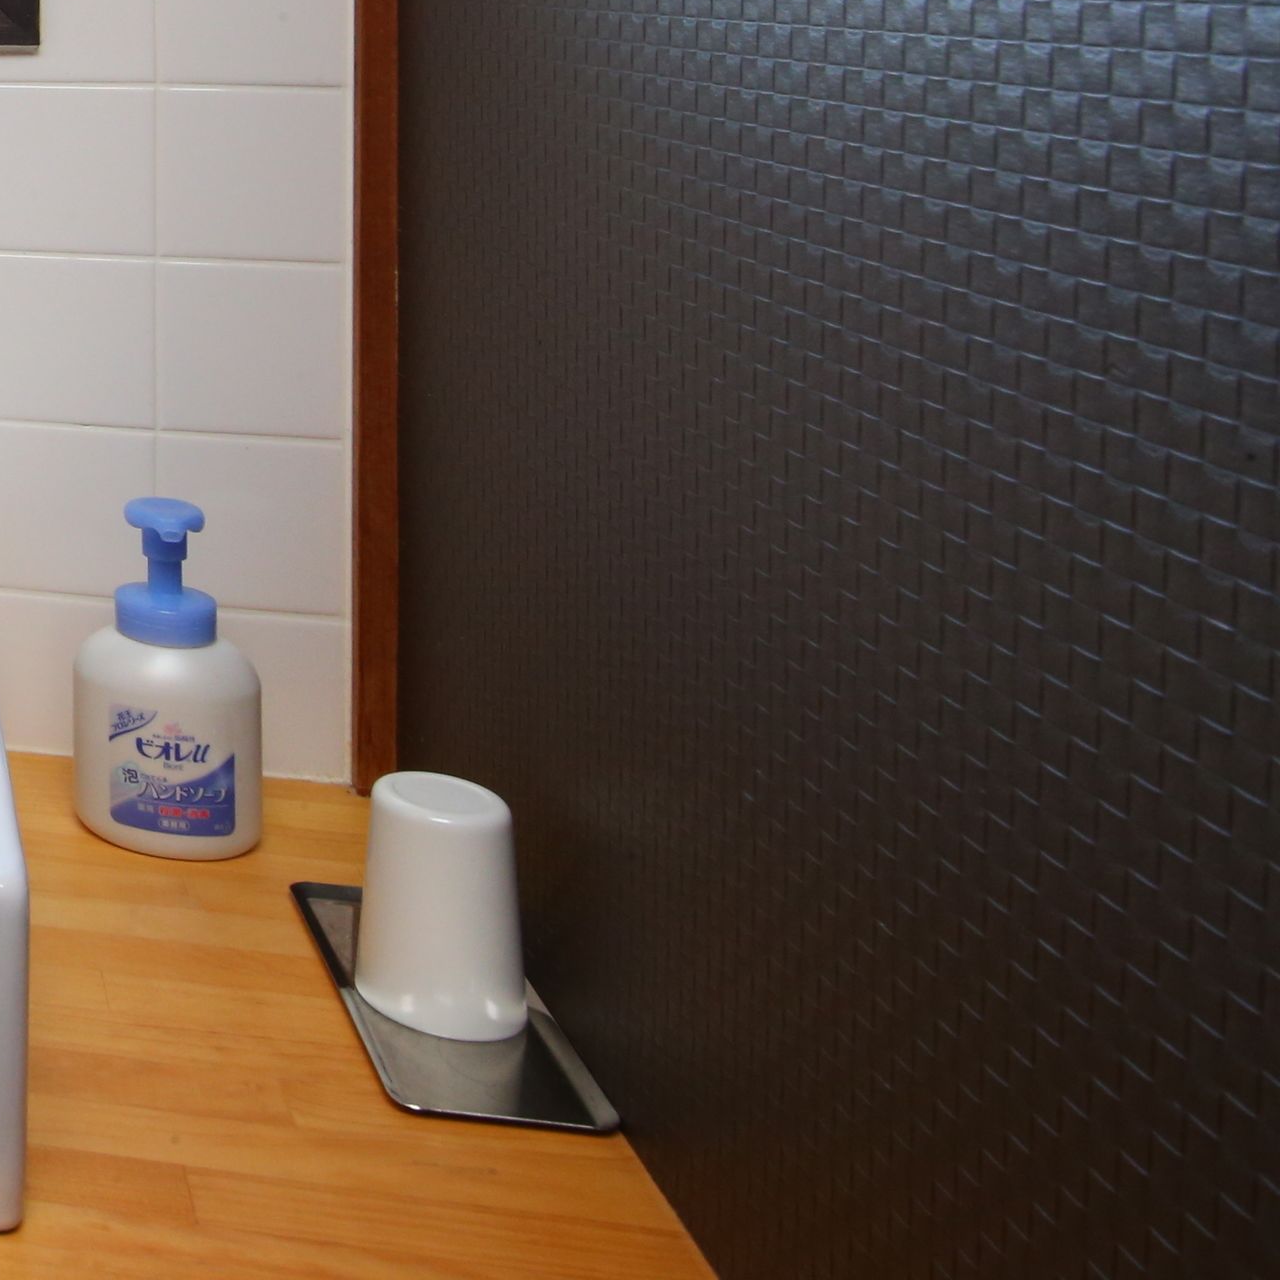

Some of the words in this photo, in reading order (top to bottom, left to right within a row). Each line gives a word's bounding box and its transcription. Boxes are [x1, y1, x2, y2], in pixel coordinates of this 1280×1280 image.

[137, 781, 228, 803] ハンドソープ
